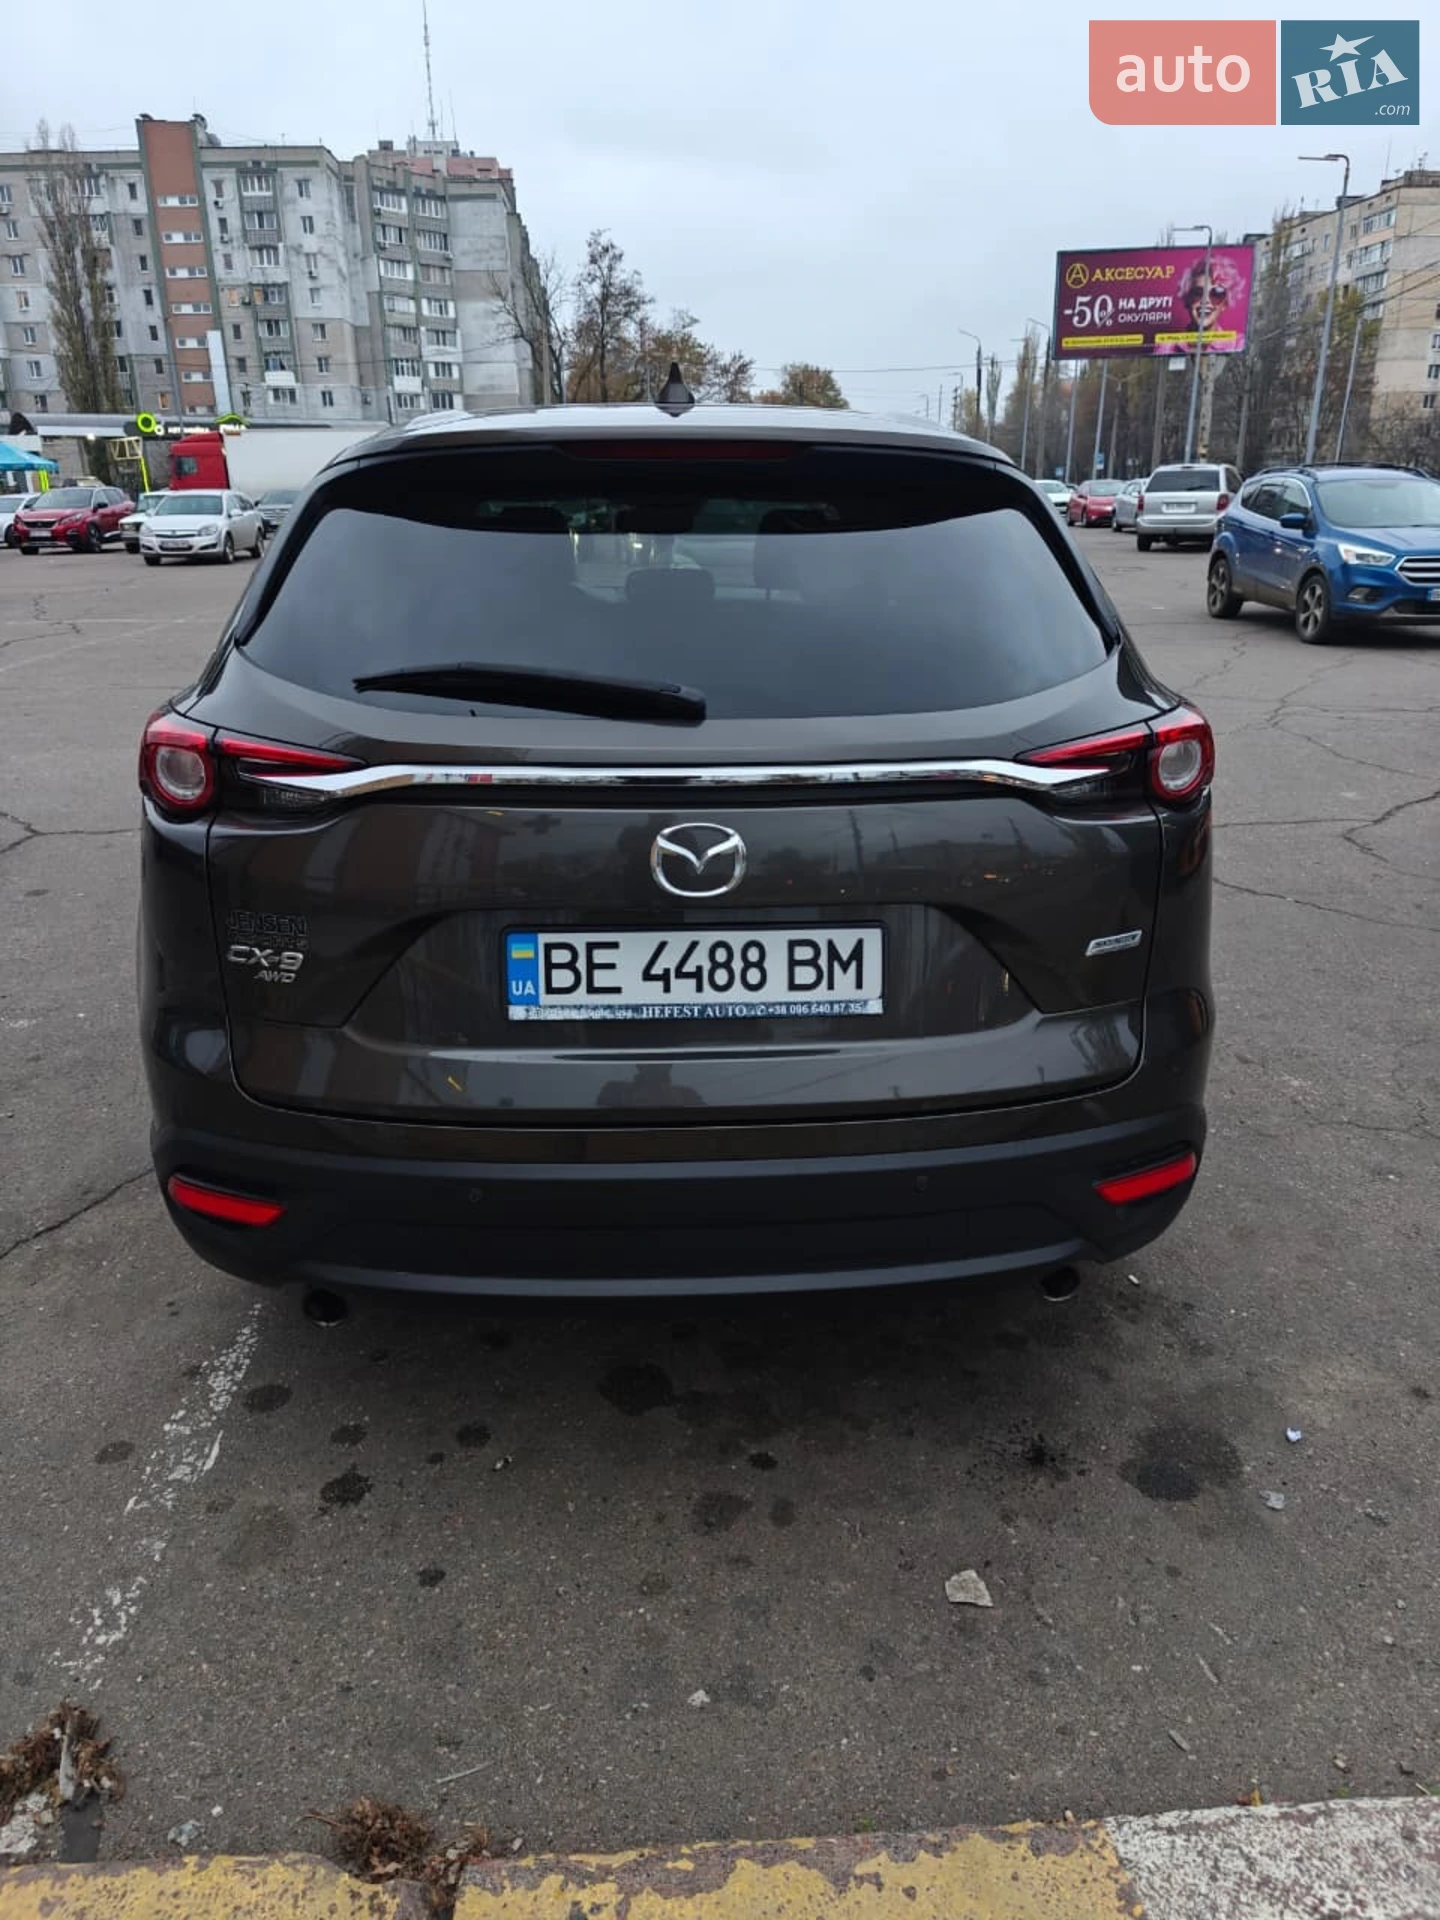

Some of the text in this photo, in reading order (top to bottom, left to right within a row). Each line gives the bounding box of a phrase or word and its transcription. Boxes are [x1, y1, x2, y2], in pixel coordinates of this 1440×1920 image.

[1091, 265, 1176, 283] АКСЕСУАР
[1118, 298, 1136, 310] НА
[1117, 311, 1172, 323] ОКУЛЯРИ
[227, 945, 304, 971] CX-9
[543, 938, 865, 995] BE 4488 BM
[252, 969, 296, 983] AWD
[511, 980, 537, 996] UA
[641, 1005, 700, 1018] HEFEST
[704, 1004, 747, 1017] AUTO
